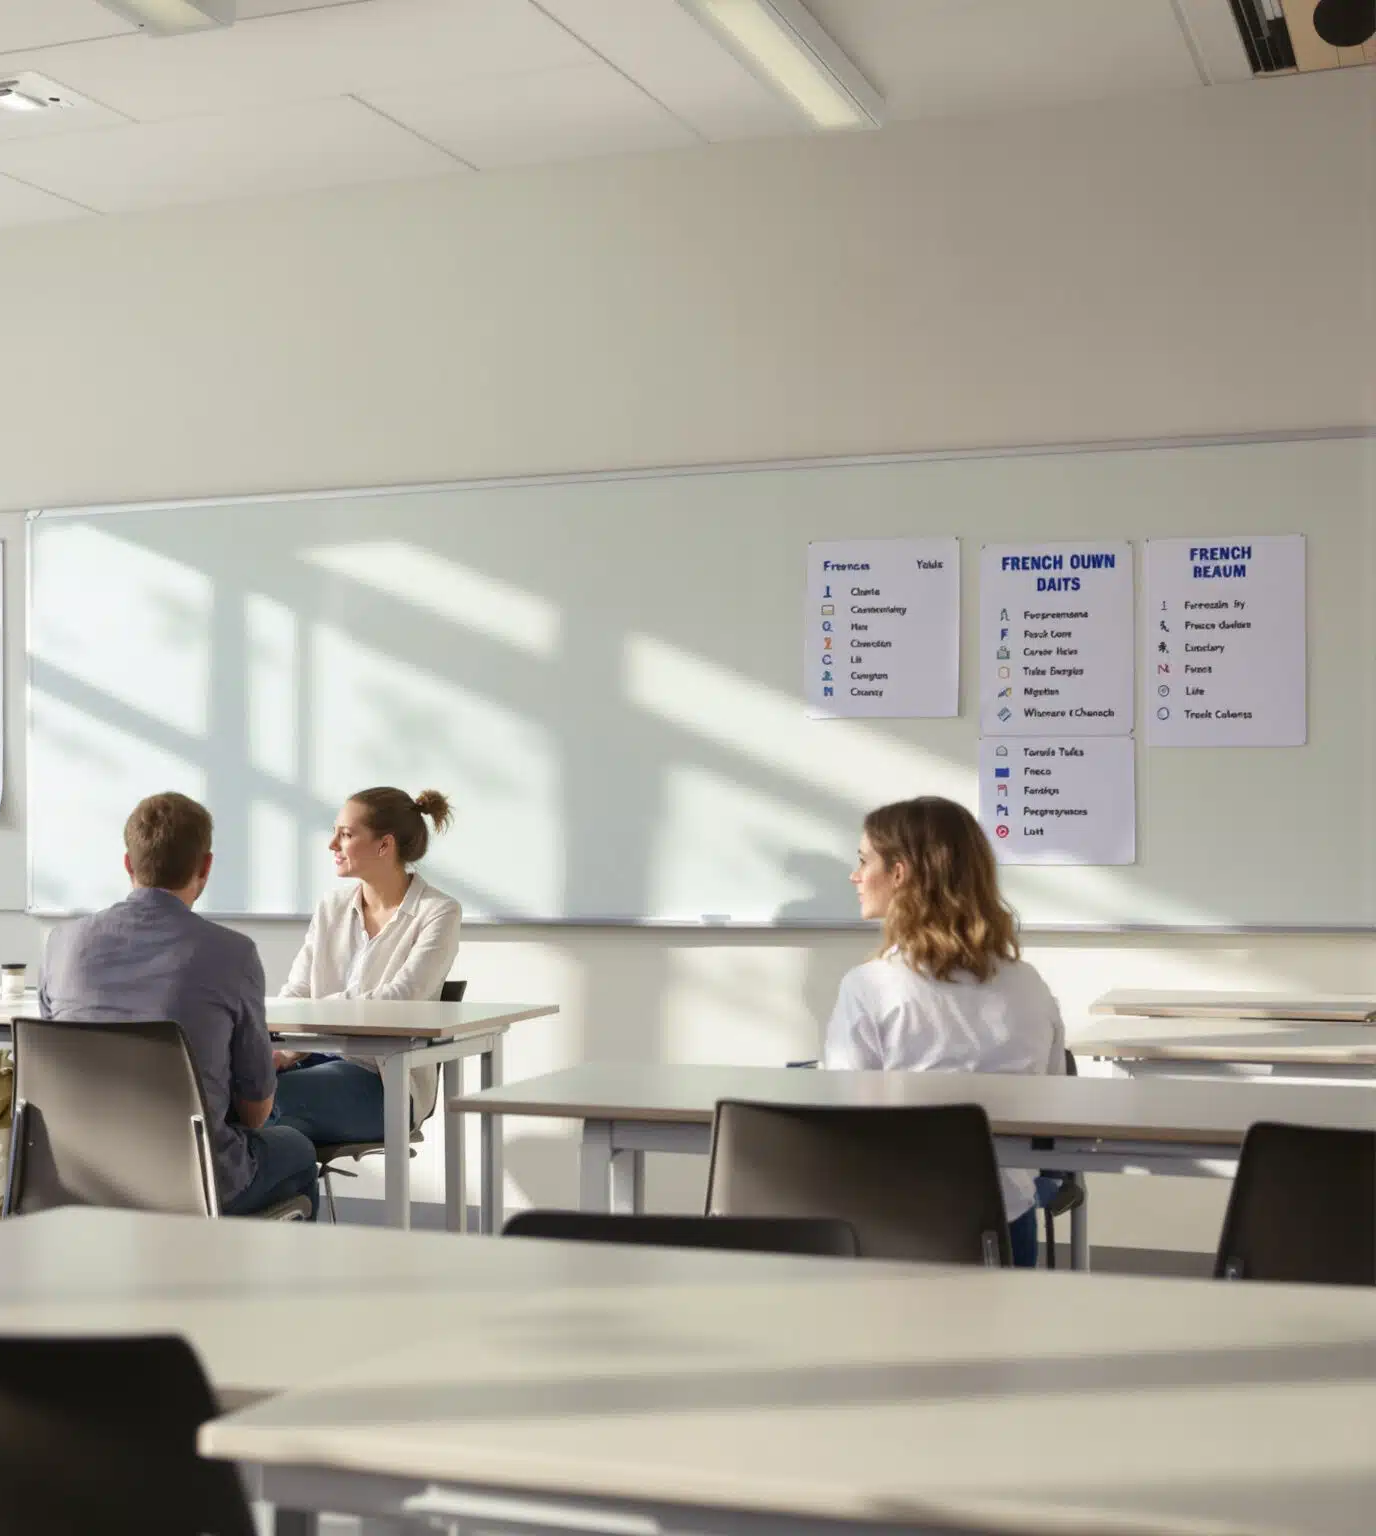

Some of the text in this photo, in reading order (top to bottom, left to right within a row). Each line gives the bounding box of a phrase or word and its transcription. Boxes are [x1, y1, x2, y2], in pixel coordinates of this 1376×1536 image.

[1190, 546, 1252, 561] FRENCH
[1002, 555, 1063, 571] FRENCH
[1037, 577, 1081, 592] DAITS
